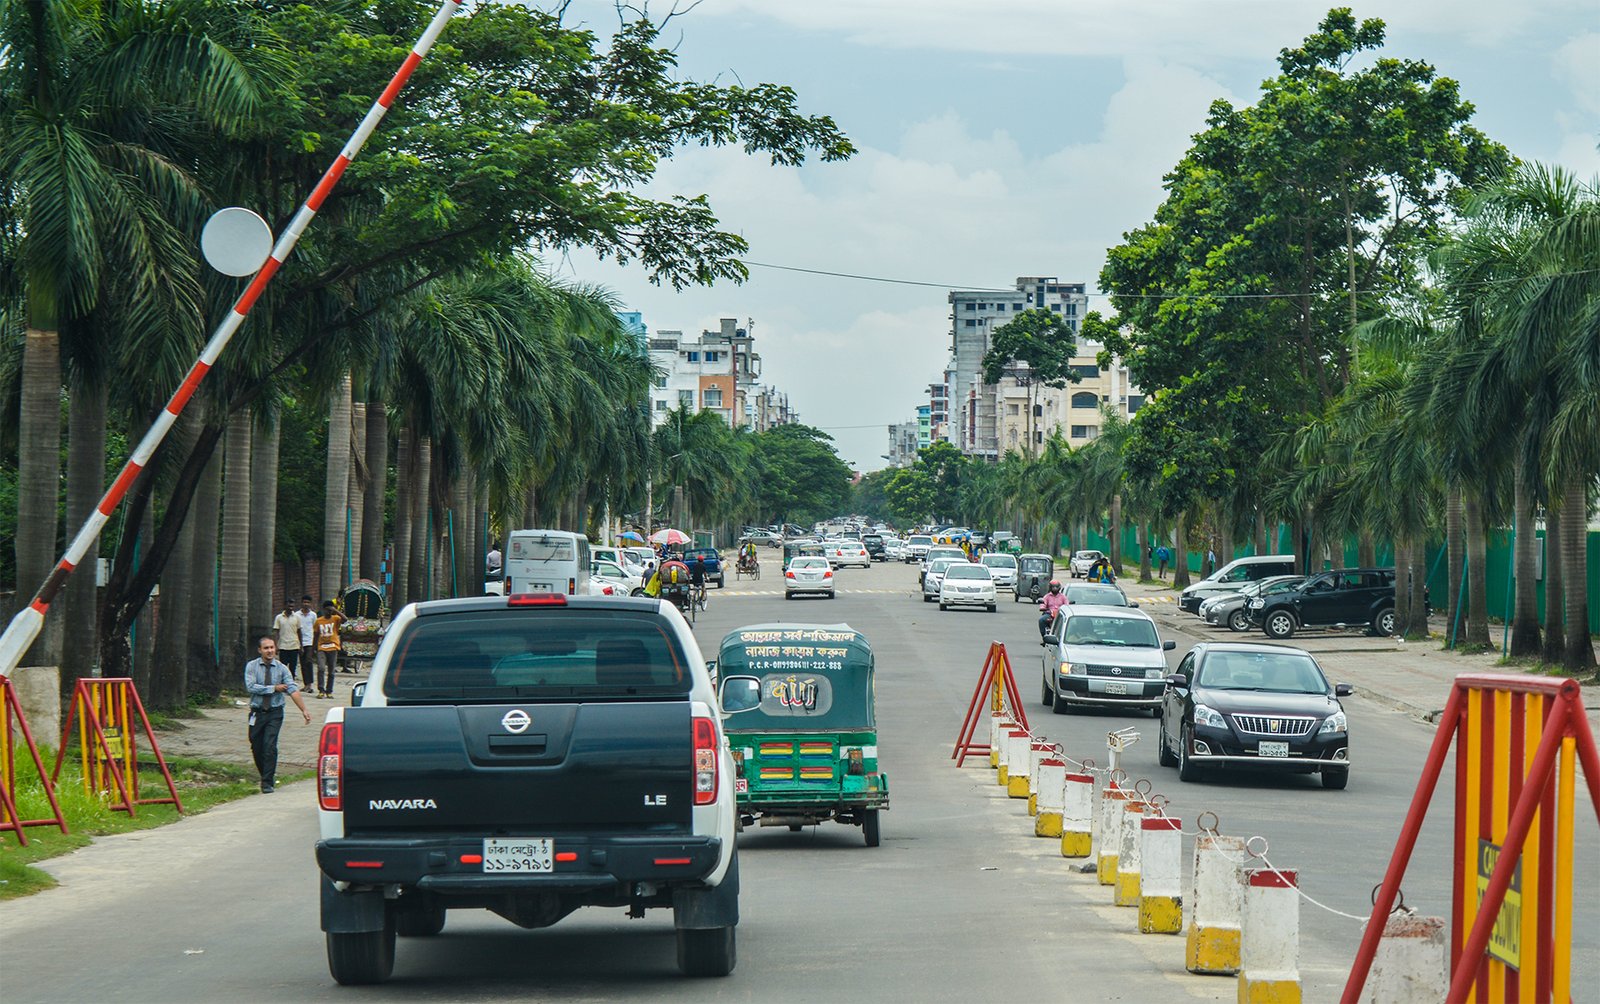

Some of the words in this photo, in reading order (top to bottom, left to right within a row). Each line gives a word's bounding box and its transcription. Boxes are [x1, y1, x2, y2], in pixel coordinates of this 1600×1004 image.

[319, 623, 335, 636] NY
[745, 646, 780, 657] নামাজ
[816, 647, 848, 659] করুন
[369, 799, 437, 810] NAVARA
[644, 794, 667, 806] LE
[488, 846, 508, 854] ঢাকা
[486, 858, 551, 870] ১১-৯৭৯৩
